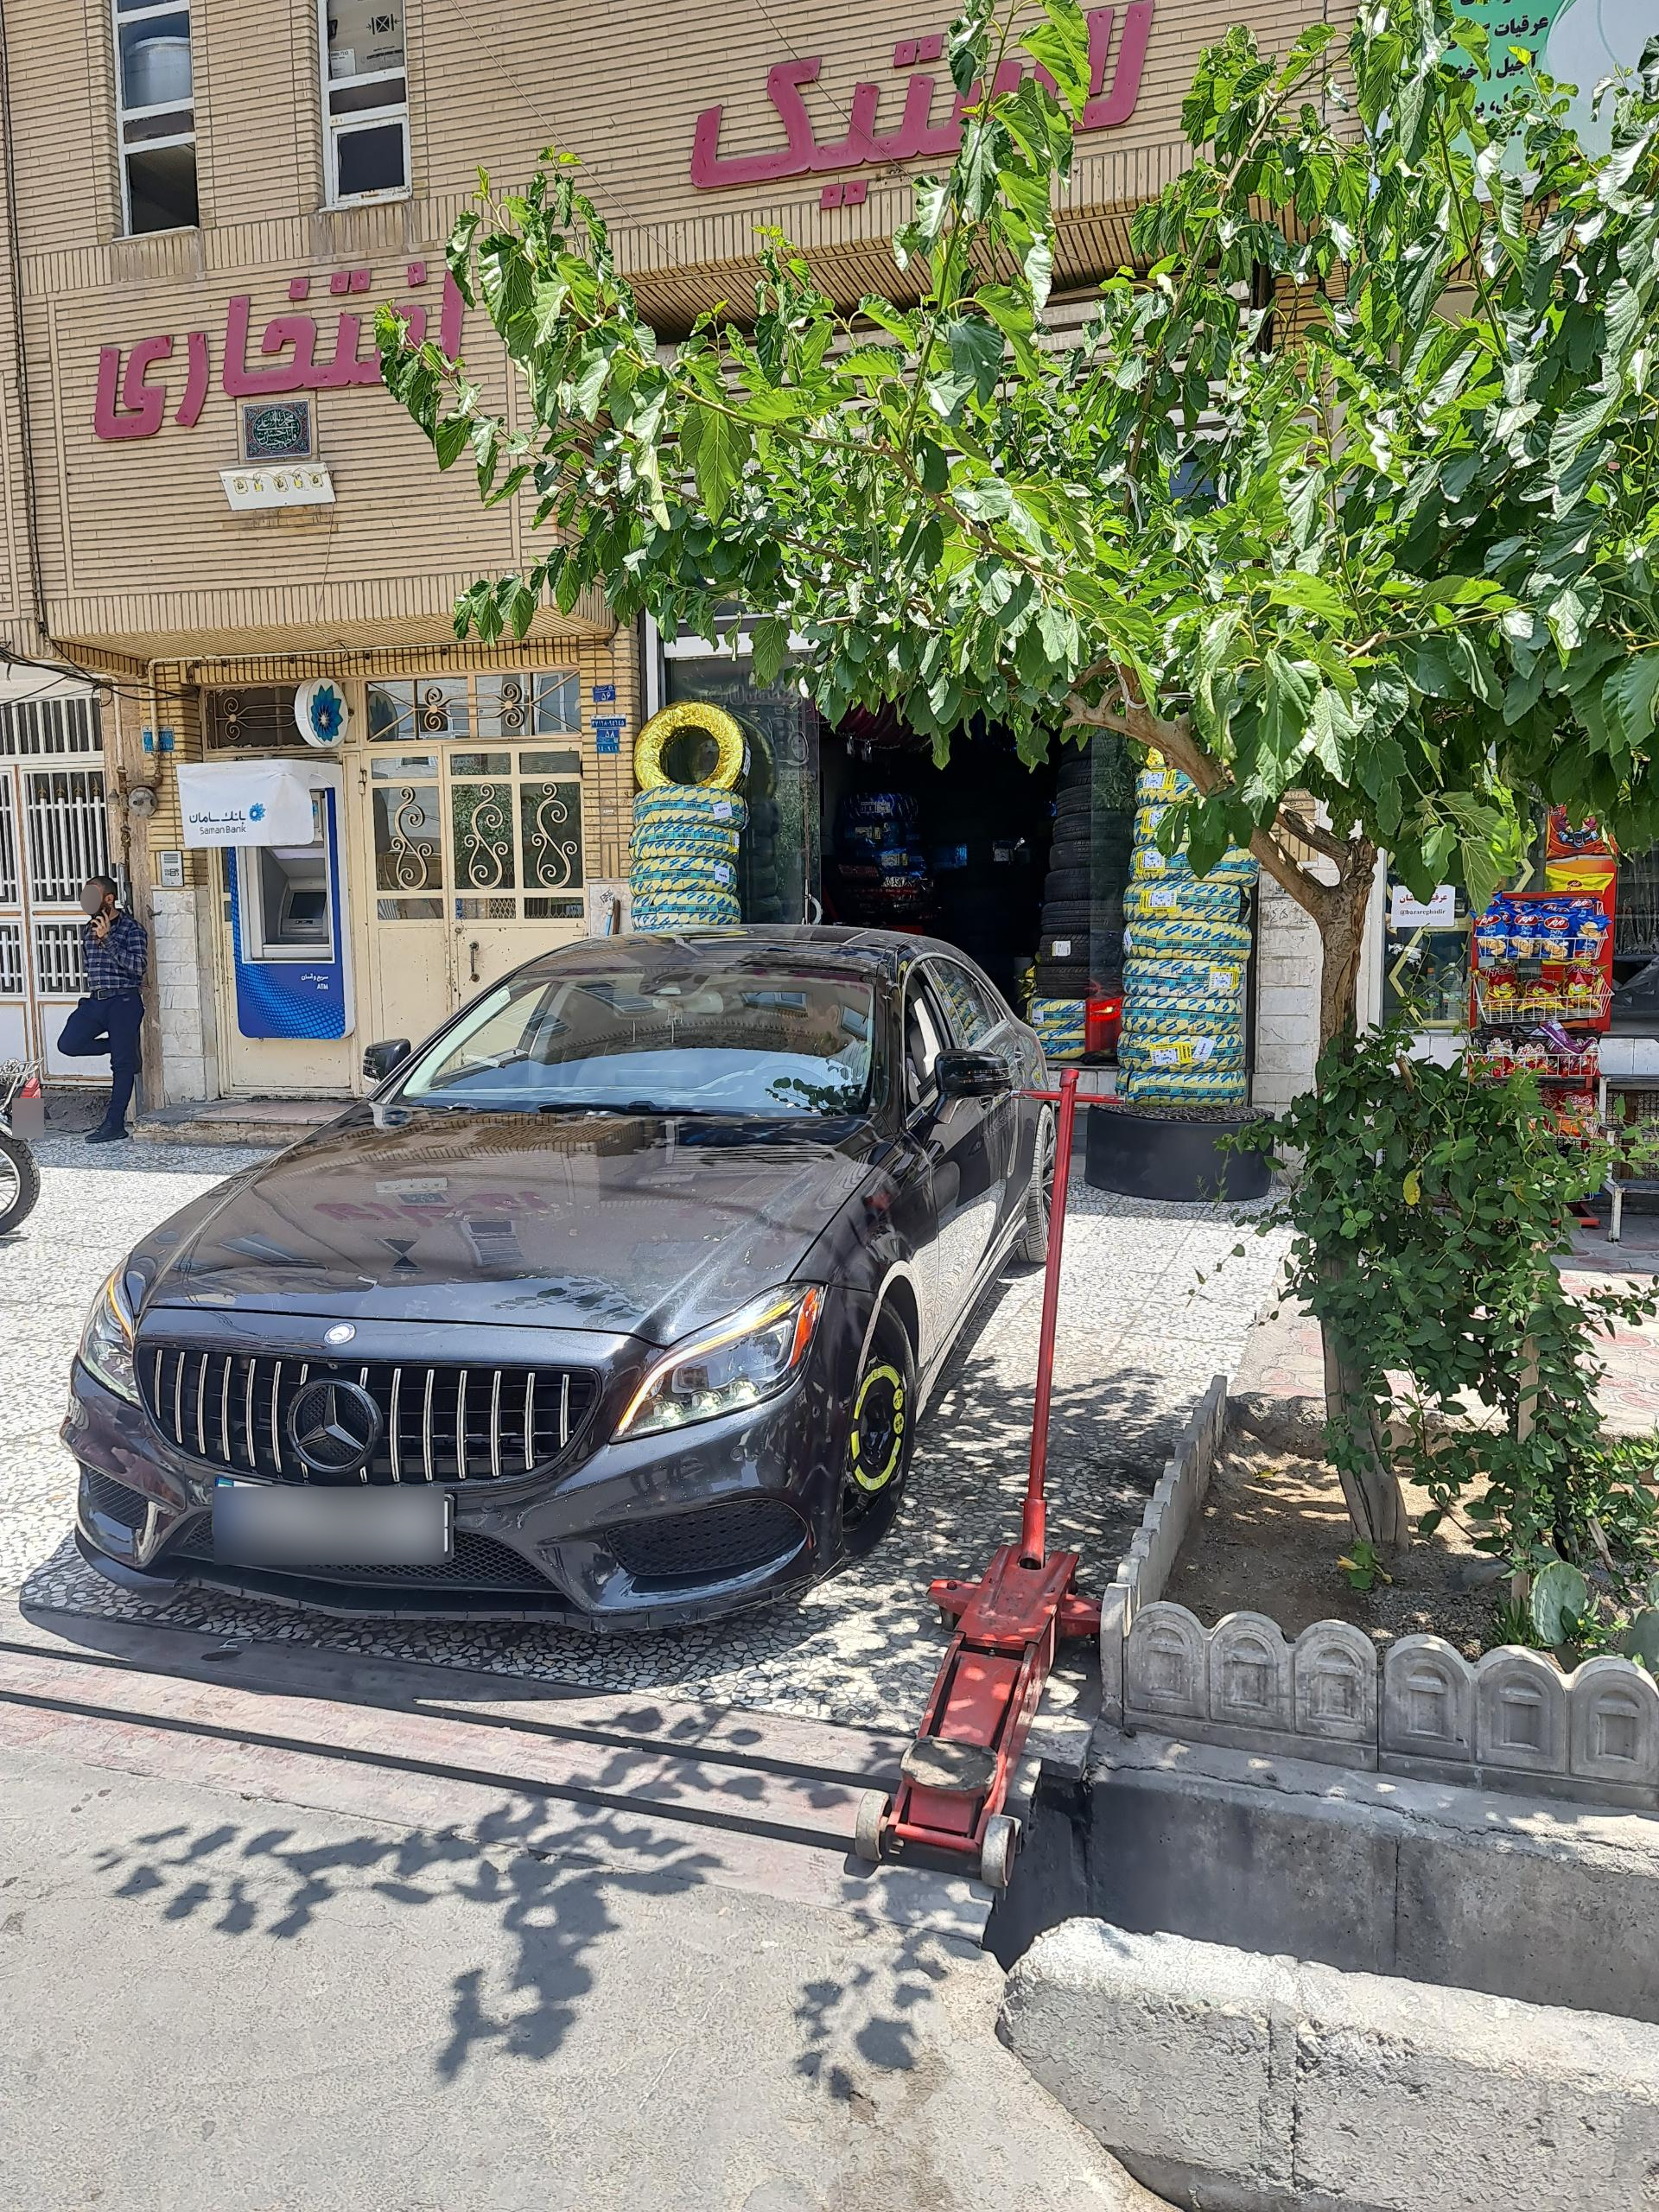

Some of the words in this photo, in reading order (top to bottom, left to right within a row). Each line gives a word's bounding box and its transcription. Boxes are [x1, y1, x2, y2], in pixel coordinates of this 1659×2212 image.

[1495, 15, 1549, 37] عرقیات
[94, 262, 465, 439] افتخاری
[189, 811, 220, 823] سامان
[226, 825, 246, 834] Bank
